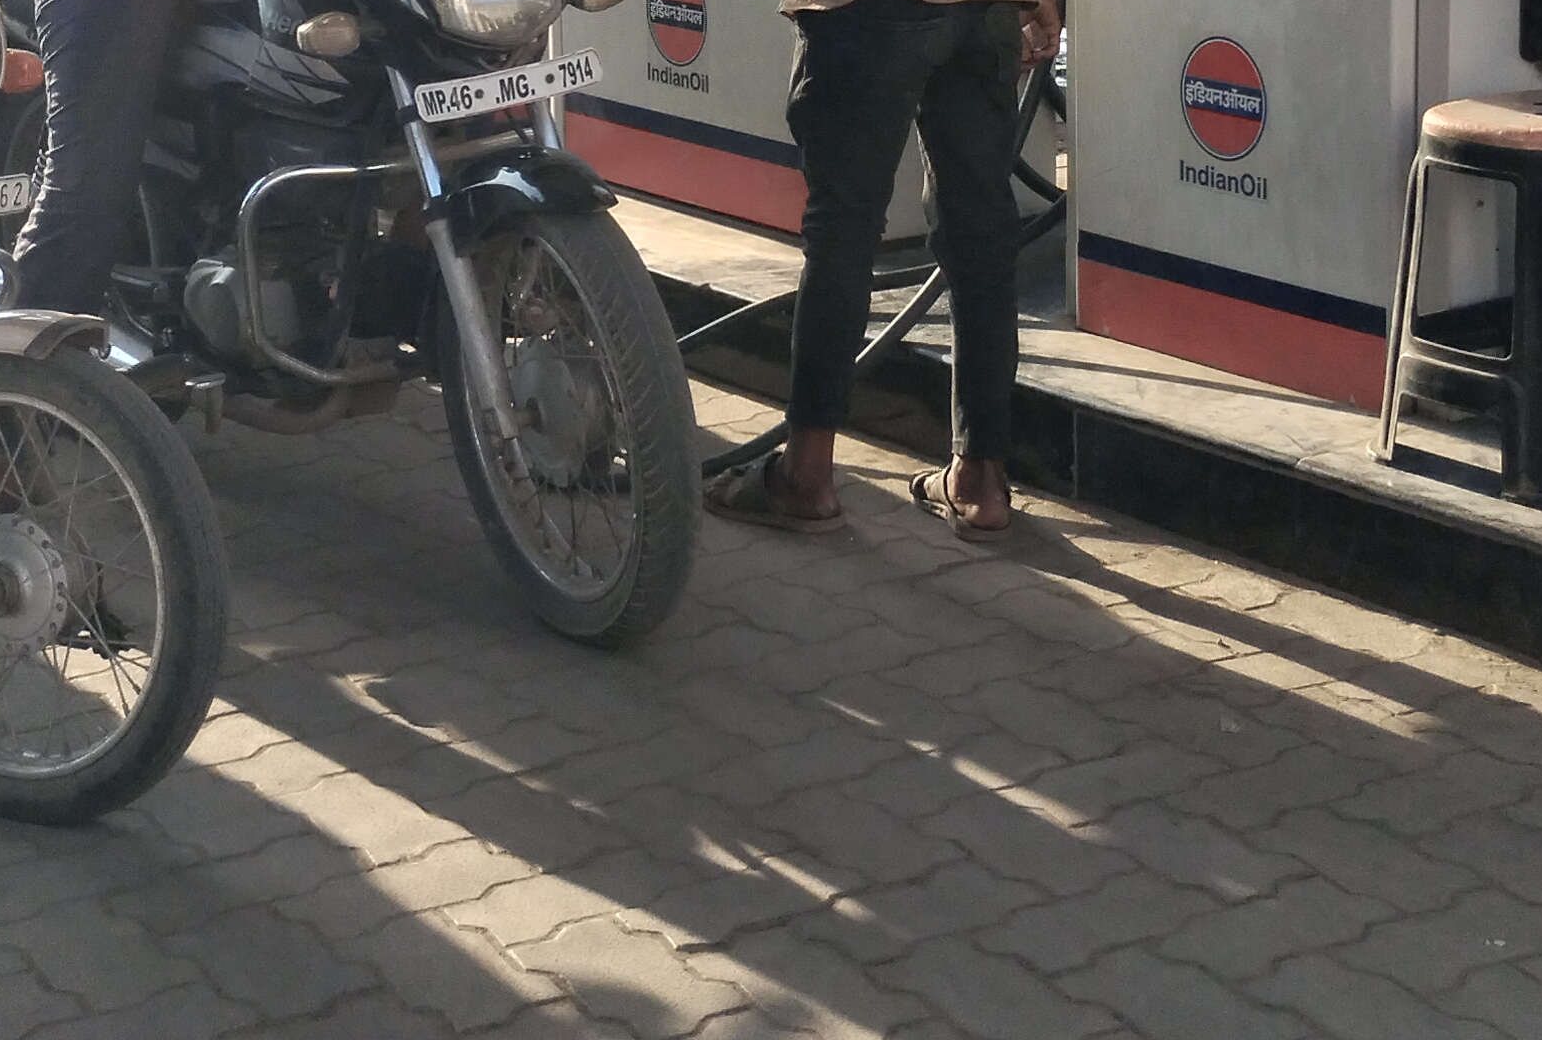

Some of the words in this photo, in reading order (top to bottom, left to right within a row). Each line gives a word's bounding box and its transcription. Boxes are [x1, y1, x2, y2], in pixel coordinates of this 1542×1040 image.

[261, 9, 303, 35] Her
[421, 84, 473, 117] MP.46
[558, 55, 594, 88] 7914
[647, 62, 709, 94] IndianOil
[1185, 79, 1261, 114] इंडियनऑयल
[1179, 159, 1267, 200] IndianOil
